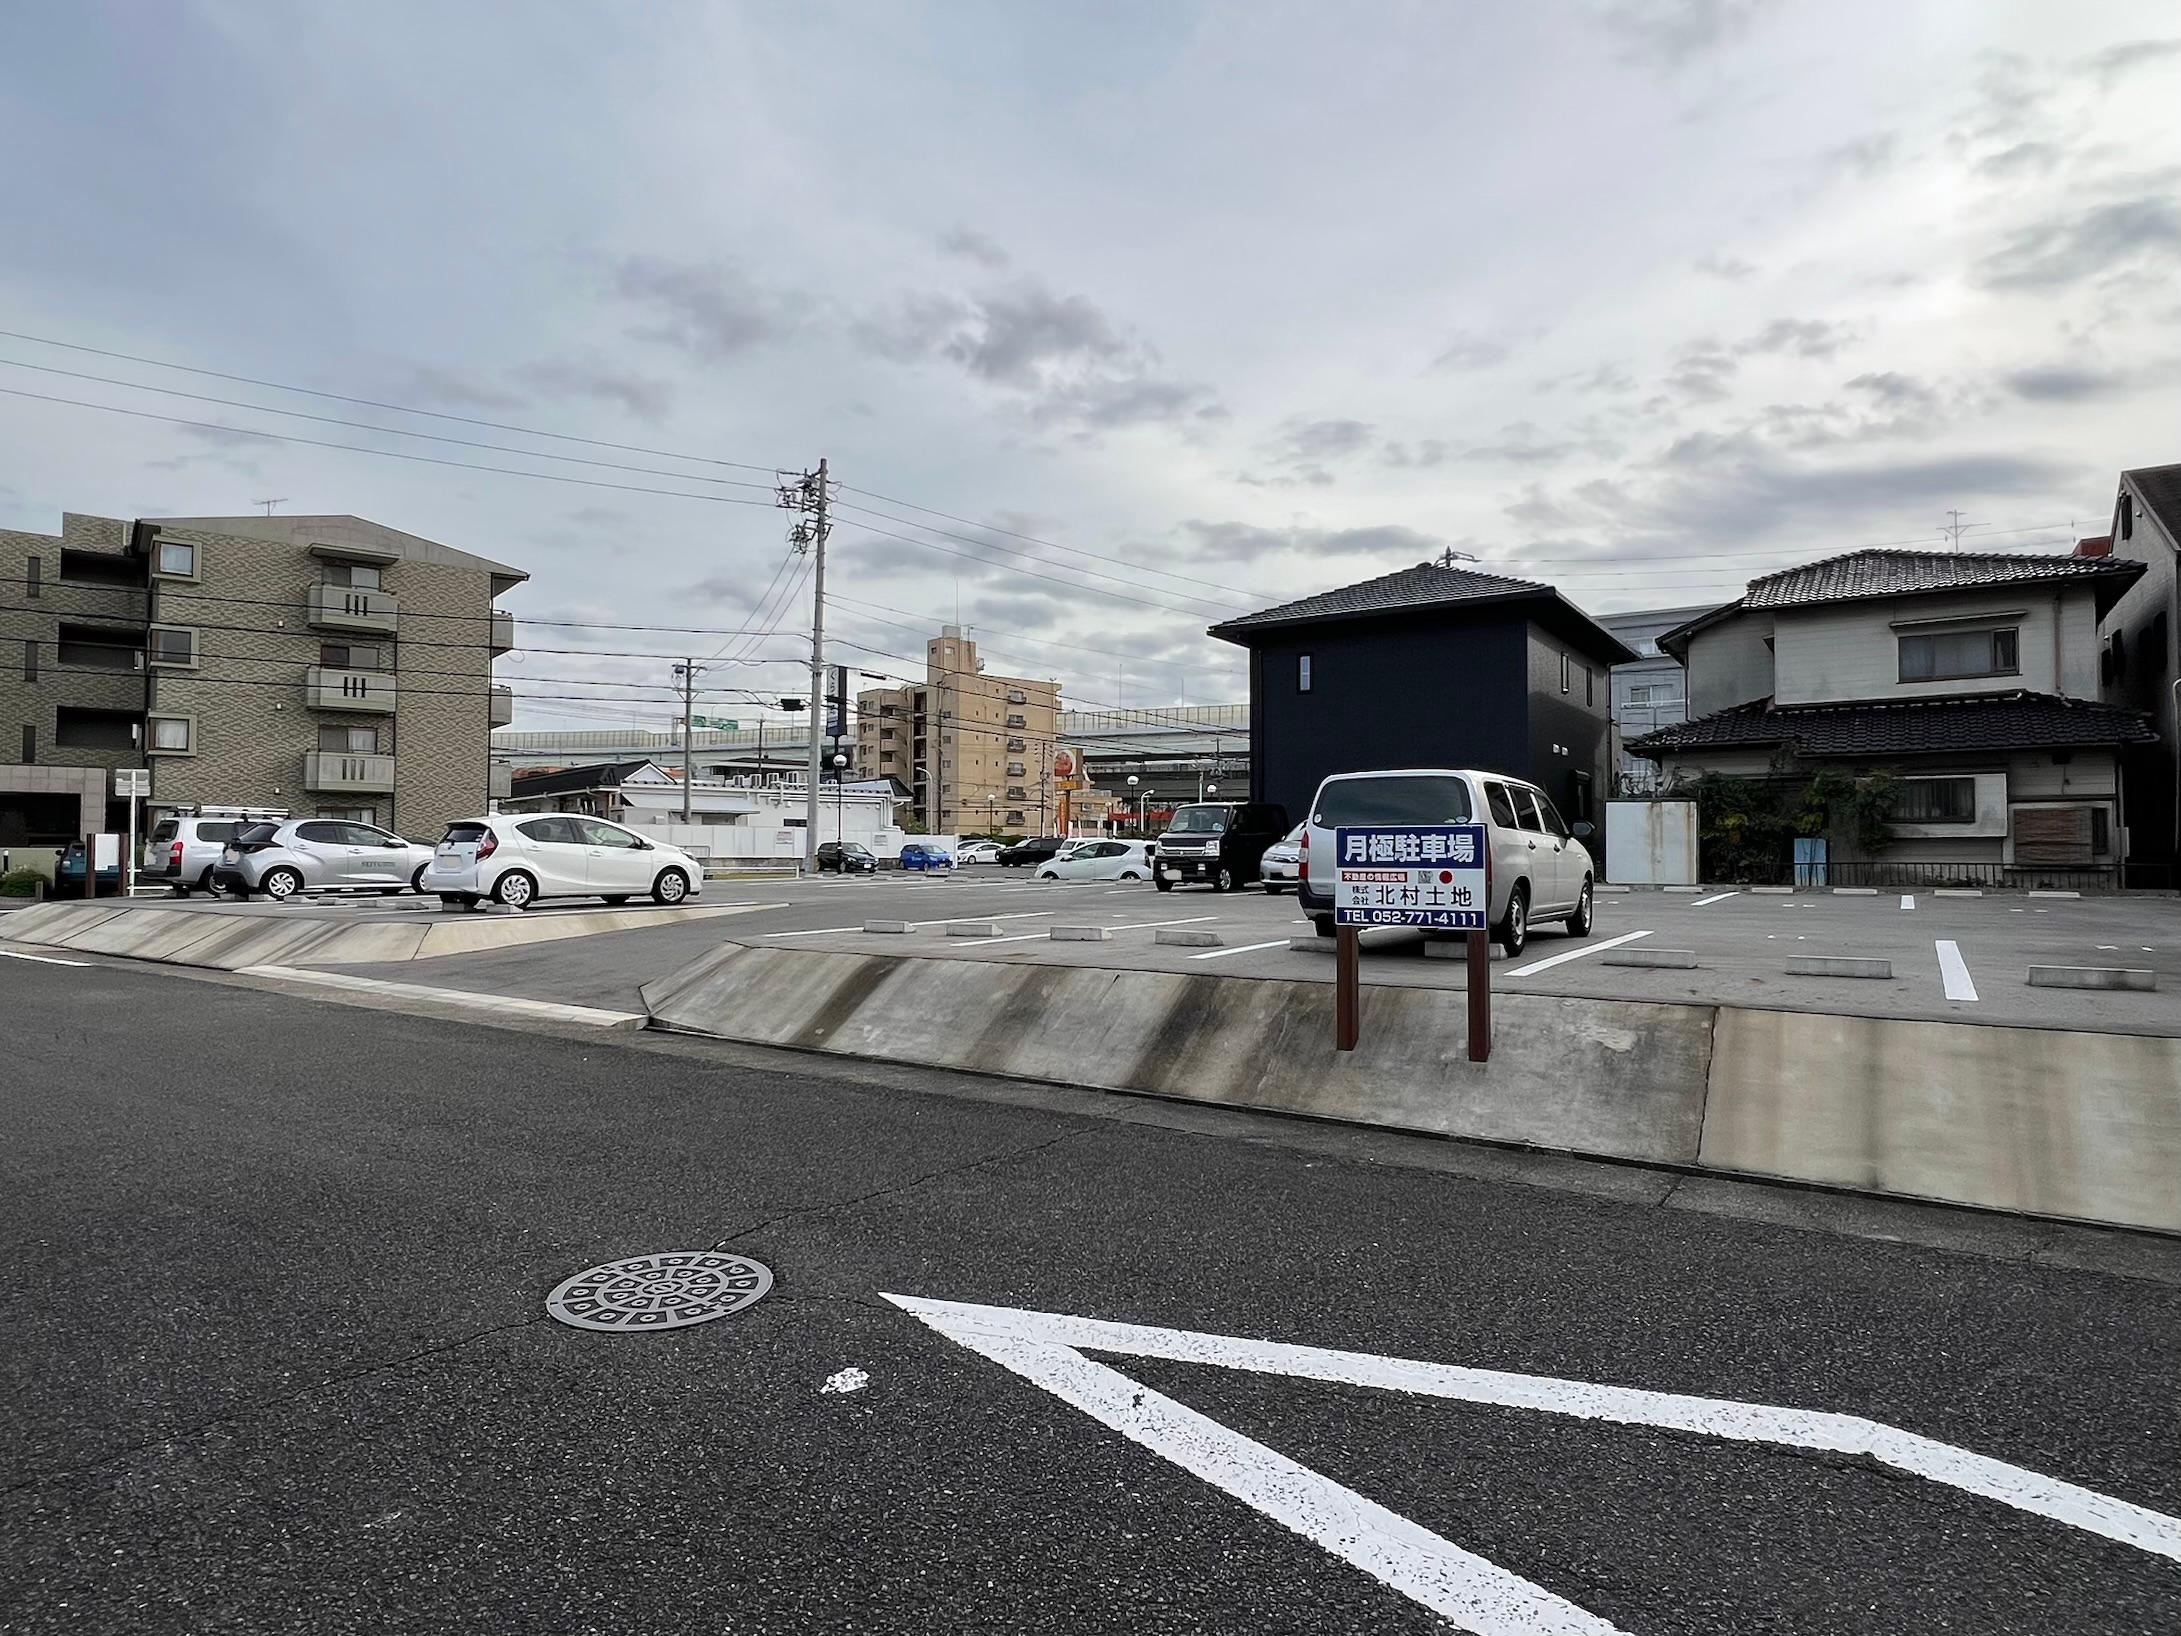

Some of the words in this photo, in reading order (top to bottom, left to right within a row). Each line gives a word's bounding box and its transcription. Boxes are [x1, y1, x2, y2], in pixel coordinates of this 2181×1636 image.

[1345, 834, 1475, 863] 月極駐車場
[1352, 885, 1369, 894] 株式
[1375, 885, 1472, 907] 北村土地
[1352, 896, 1369, 906] 会社
[1344, 910, 1369, 922] TEL
[1372, 911, 1477, 926] 052-771-4111
